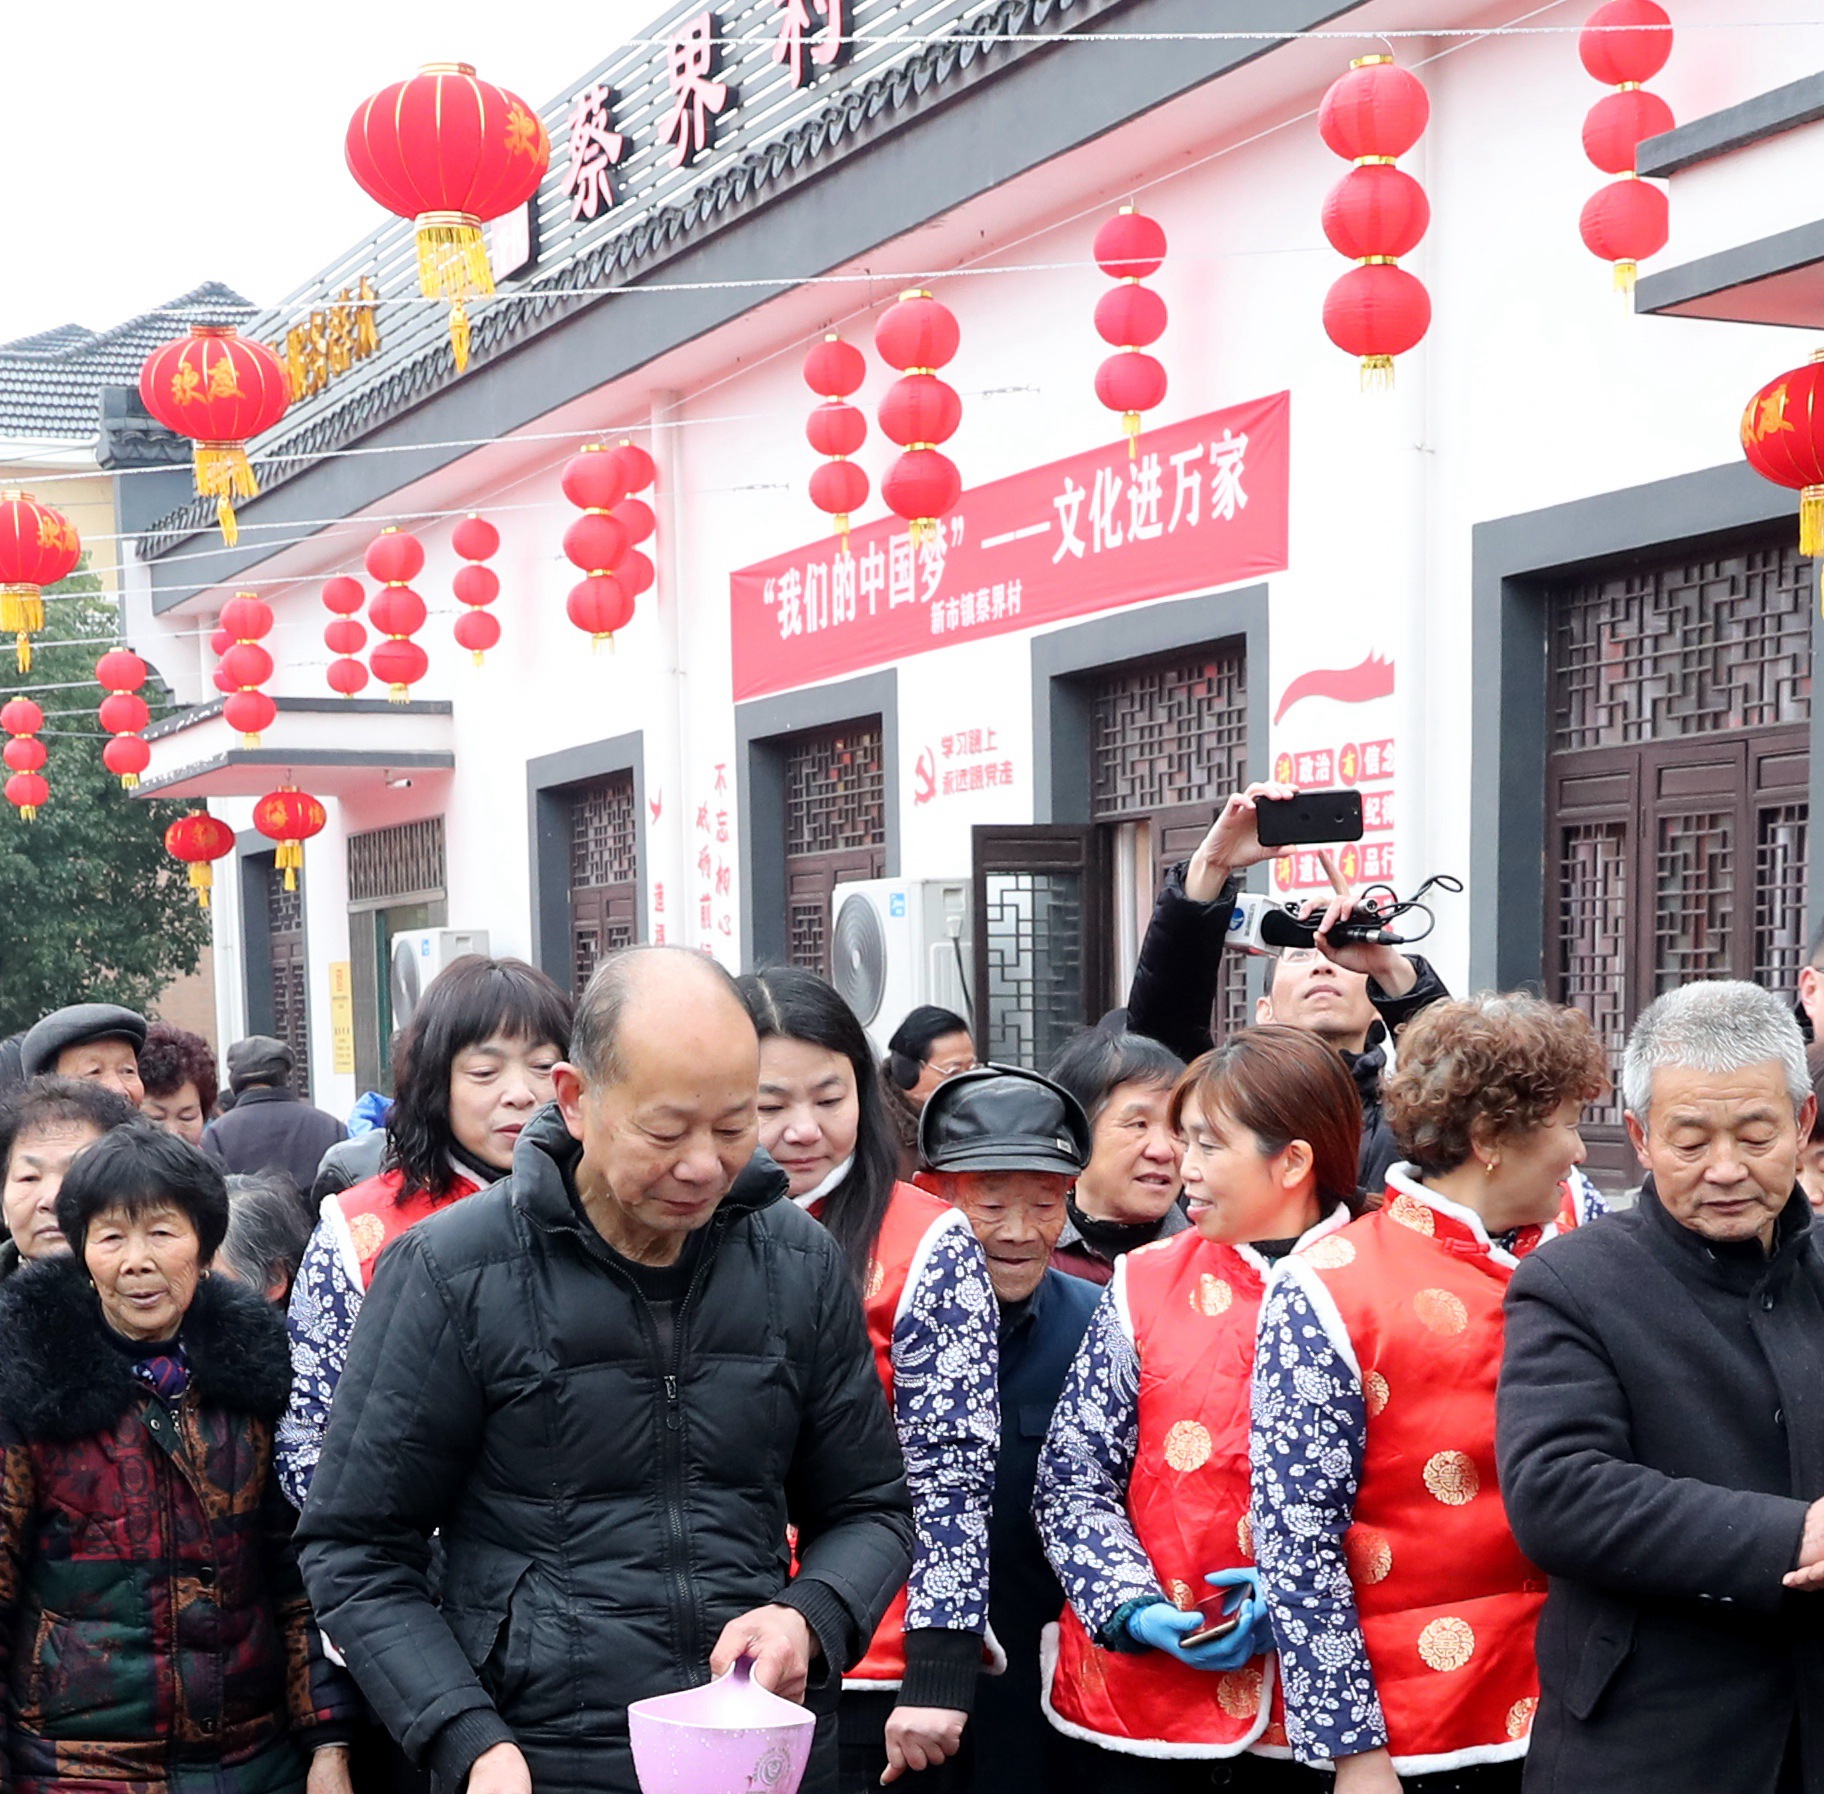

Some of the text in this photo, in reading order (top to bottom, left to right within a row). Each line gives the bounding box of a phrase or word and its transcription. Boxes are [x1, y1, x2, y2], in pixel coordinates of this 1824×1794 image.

[170, 357, 247, 406] 欢庆
[930, 579, 1023, 635] 新市镇蔡界村
[714, 763, 732, 937] 不忘初心
